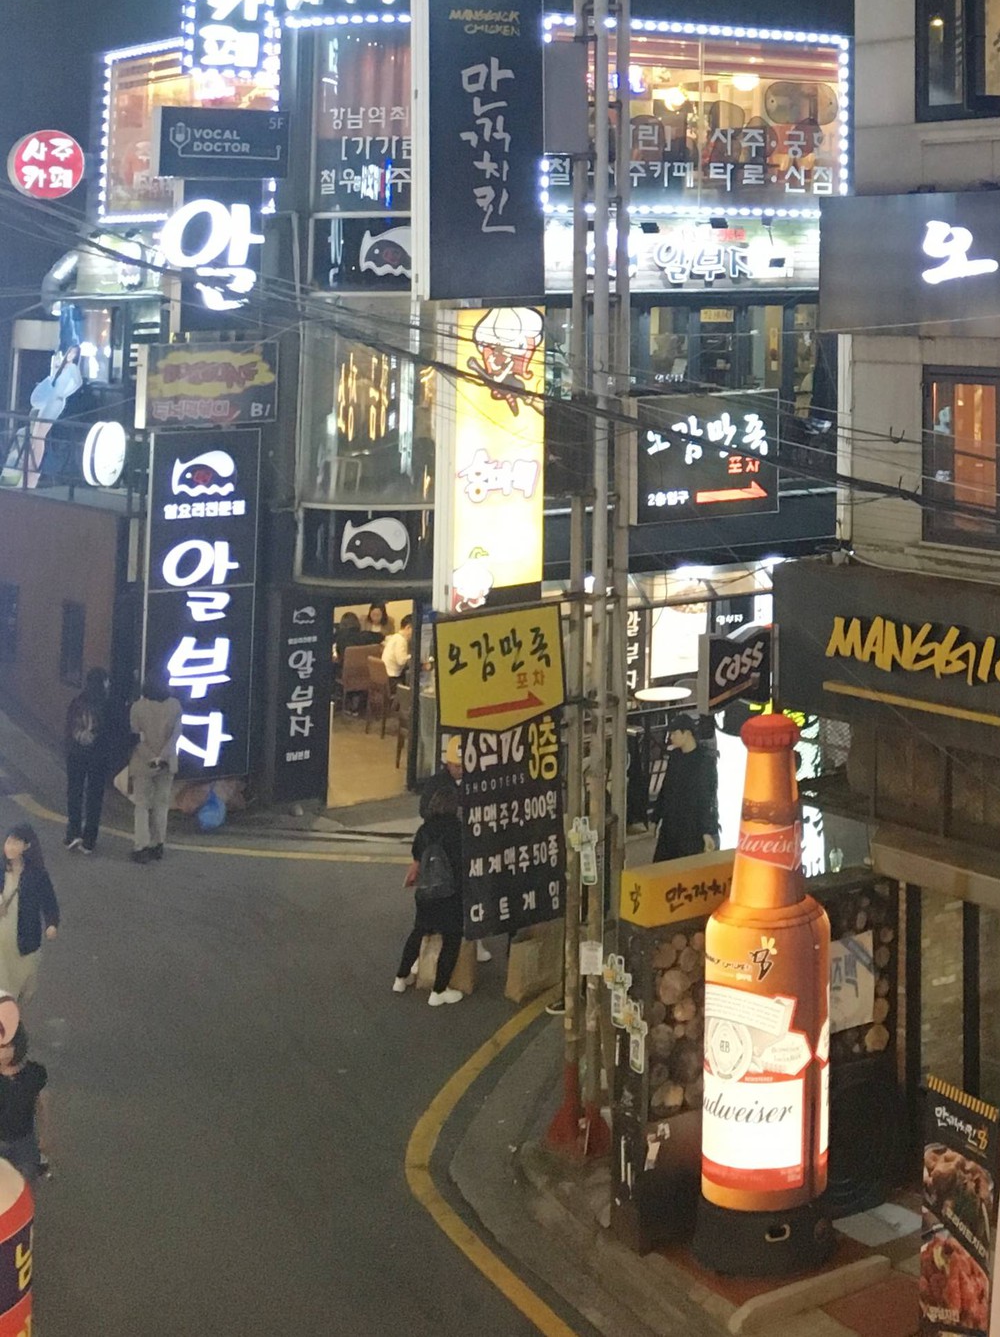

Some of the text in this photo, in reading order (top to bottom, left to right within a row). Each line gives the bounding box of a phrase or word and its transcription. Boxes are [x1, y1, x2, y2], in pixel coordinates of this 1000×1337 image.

[193, 128, 241, 141] VOCAL
[268, 116, 285, 130] 5F
[22, 137, 75, 162] 사주
[193, 141, 251, 154] DOCTOR
[21, 165, 74, 190] 카페
[161, 538, 240, 768] 알부자
[448, 626, 552, 683] 오감만족
[516, 669, 546, 689] 포차
[528, 715, 559, 780] 3층
[465, 772, 526, 796] SHOOTERS
[467, 790, 558, 838] 생맥주 2,900원
[468, 834, 560, 879] 세계맥주 50종
[469, 879, 561, 924] 다트게임
[664, 875, 733, 912] 만끽치
[702, 1092, 793, 1124] udweiser
